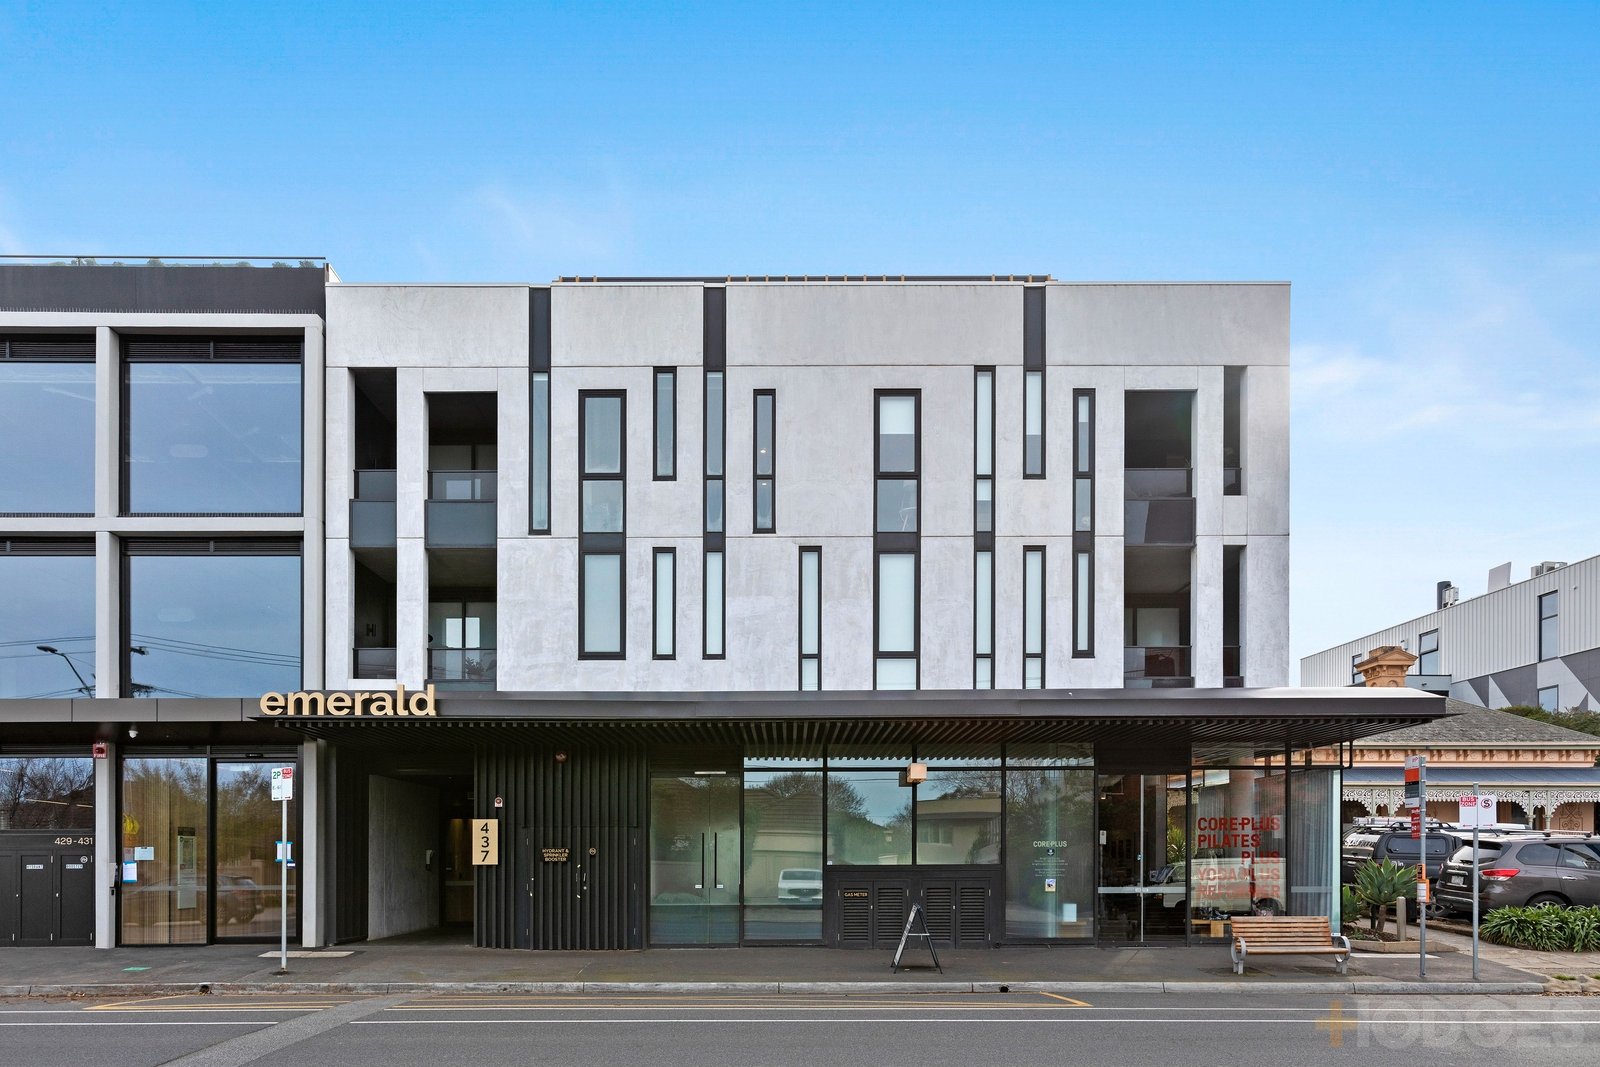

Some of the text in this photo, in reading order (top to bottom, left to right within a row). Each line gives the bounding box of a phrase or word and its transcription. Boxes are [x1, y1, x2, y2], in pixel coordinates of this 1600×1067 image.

[259, 683, 437, 716] emerald
[272, 771, 281, 779] 2P
[54, 837, 93, 845] 429-431
[1197, 834, 1261, 848] PILATES
[1241, 851, 1281, 864] PLUS
